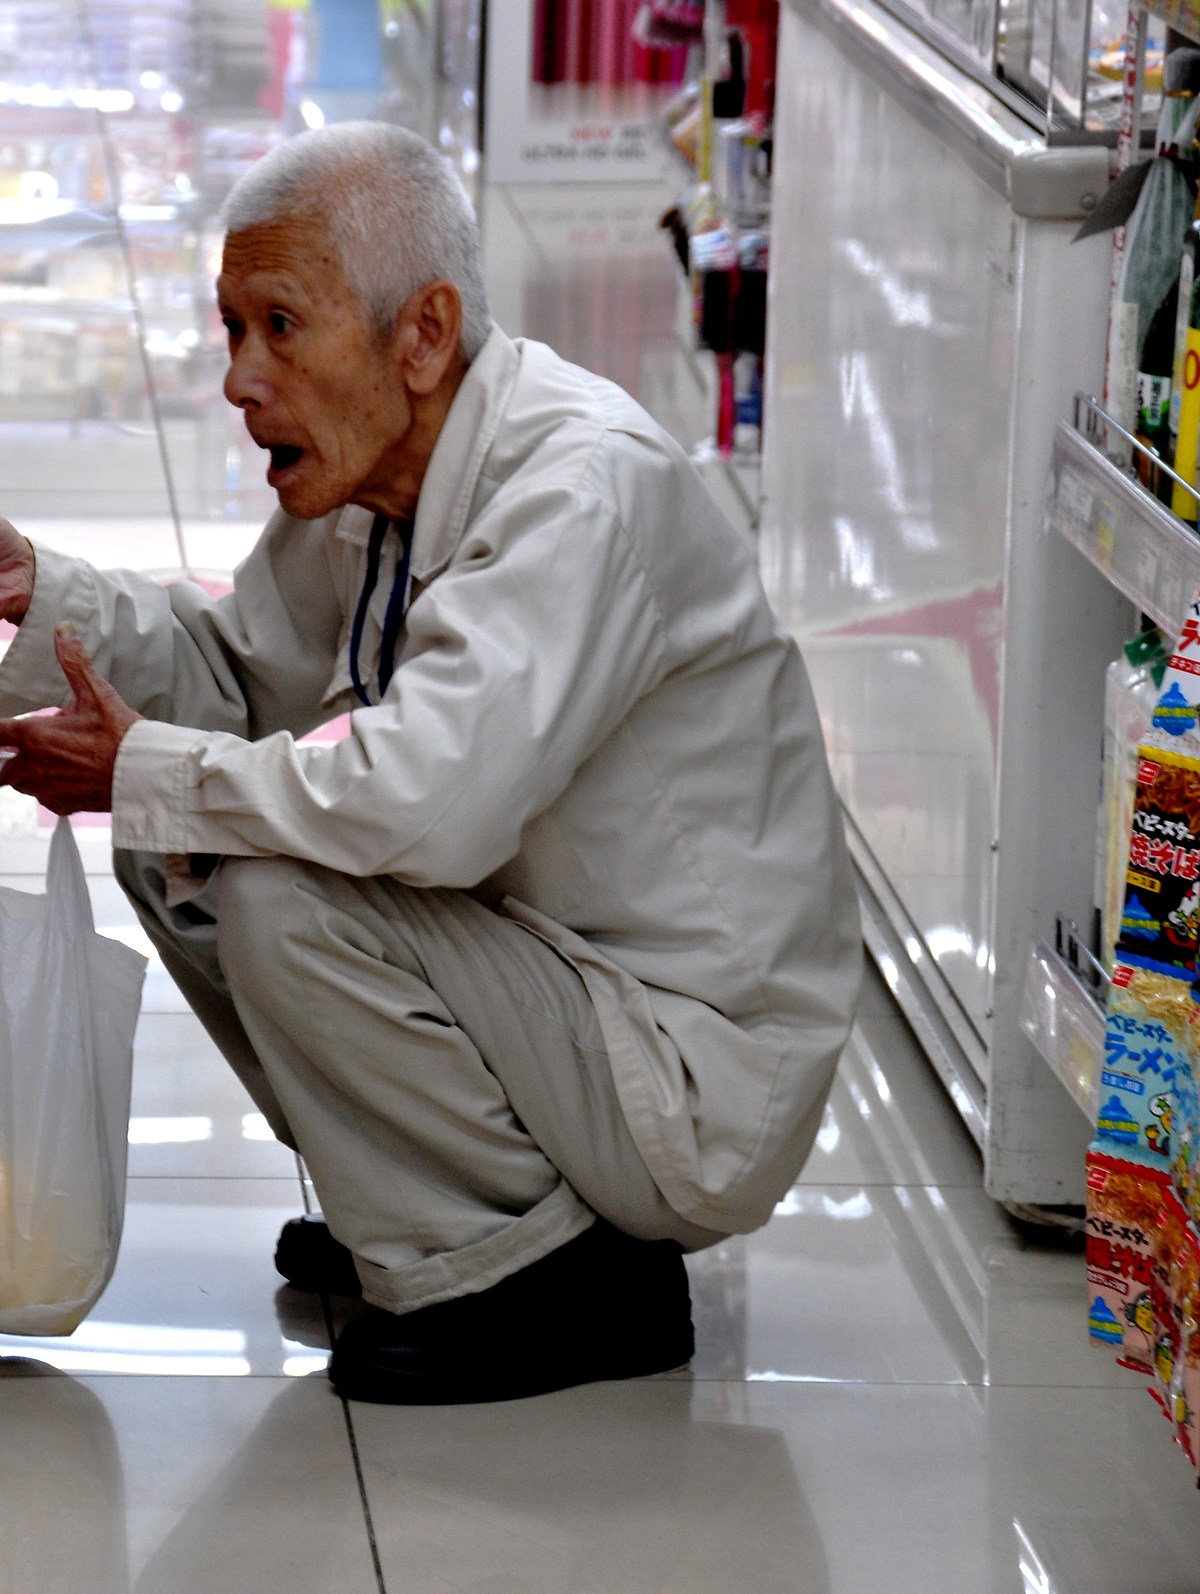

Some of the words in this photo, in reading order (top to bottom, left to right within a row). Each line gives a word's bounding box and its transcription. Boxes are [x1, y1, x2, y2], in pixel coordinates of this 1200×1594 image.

[1133, 810, 1195, 841] ベビースター
[1106, 1014, 1173, 1043] ベビースター
[1086, 1216, 1150, 1246] ベビースター
